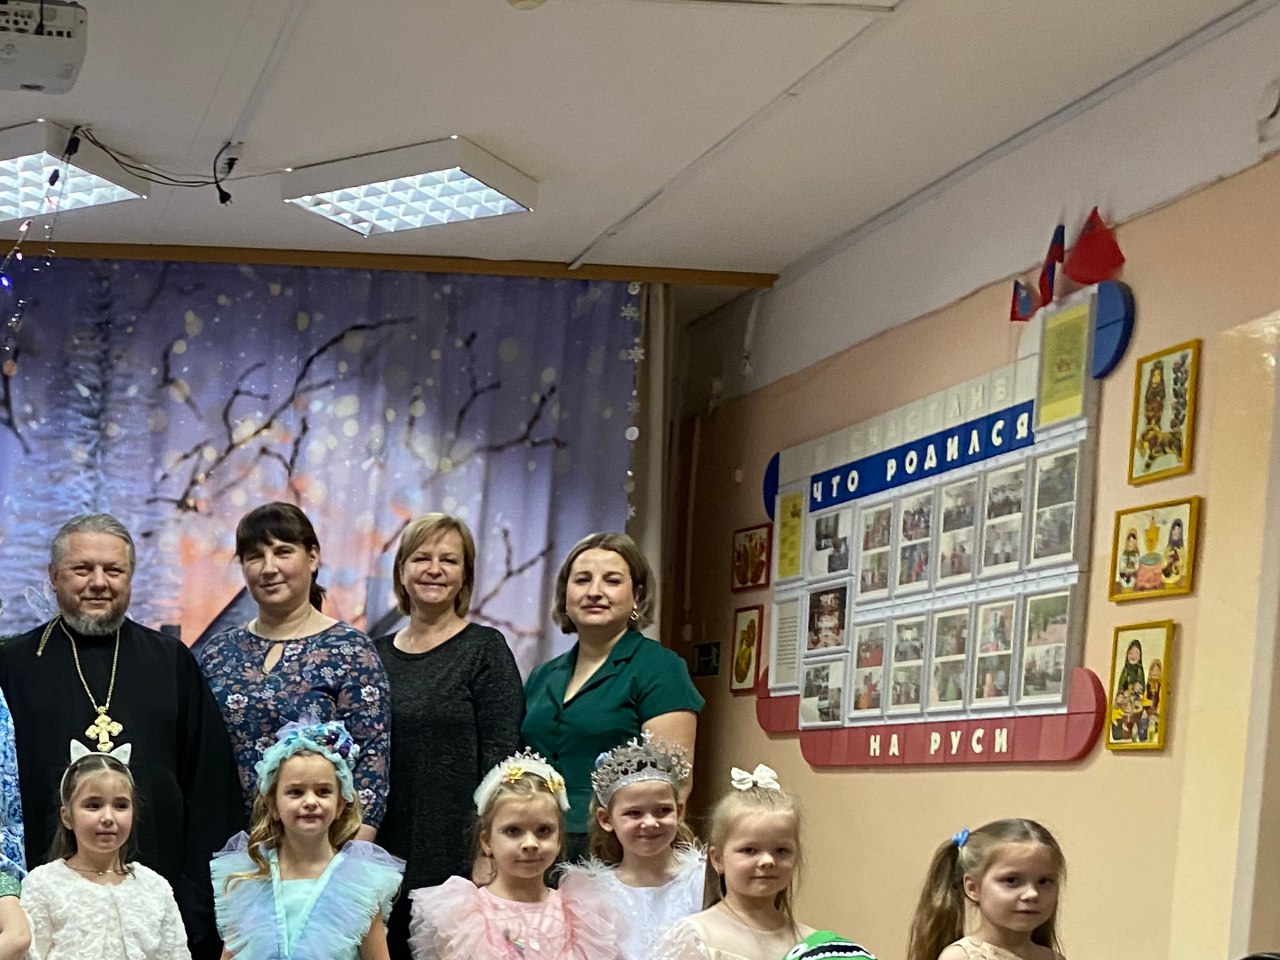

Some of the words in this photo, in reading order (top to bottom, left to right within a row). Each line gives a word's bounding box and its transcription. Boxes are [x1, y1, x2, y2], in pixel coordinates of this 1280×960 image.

[812, 470, 859, 502] ЧТО
[887, 413, 1029, 481] РОДИЛСЯ
[869, 734, 899, 757] НА
[930, 728, 1008, 755] РУСИ
